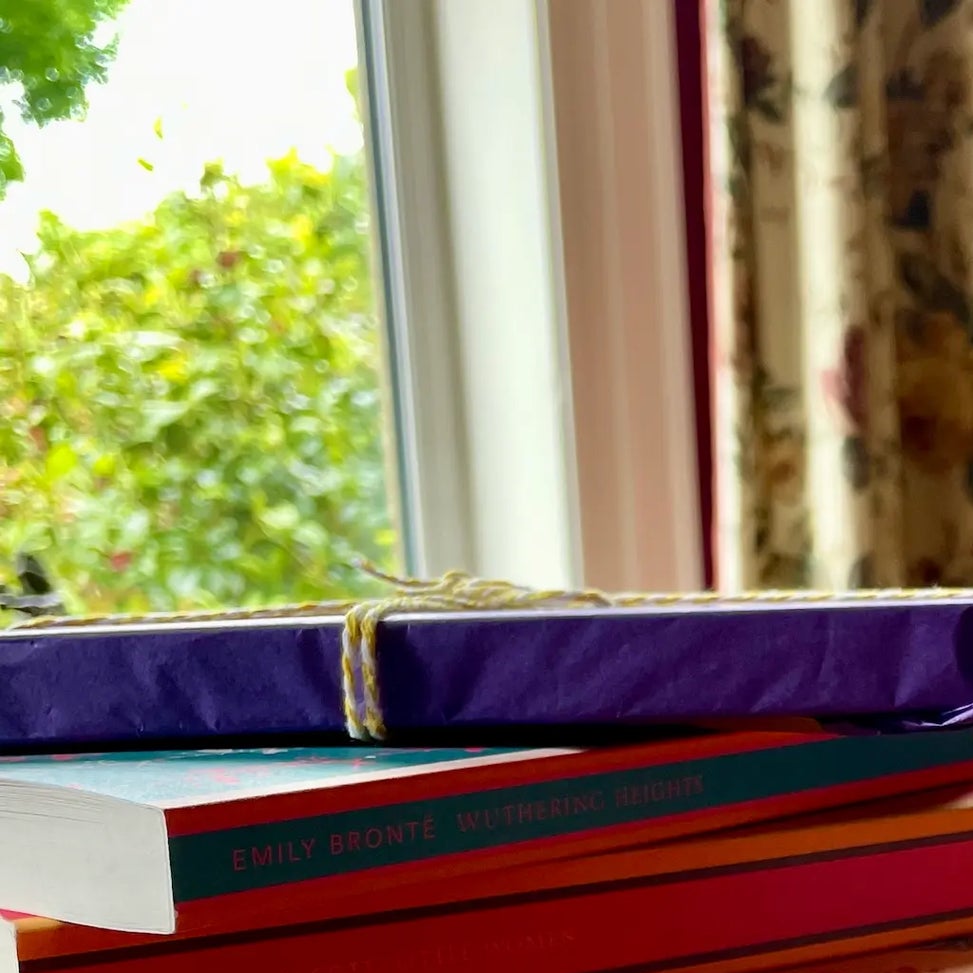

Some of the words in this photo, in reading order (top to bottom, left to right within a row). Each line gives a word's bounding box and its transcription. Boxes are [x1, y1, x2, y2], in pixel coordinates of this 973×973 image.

[455, 791, 604, 834] WUTHERING
[615, 776, 705, 810] HEIGHTS
[232, 838, 317, 872] EMILY
[330, 816, 437, 856] BRONTÉ
